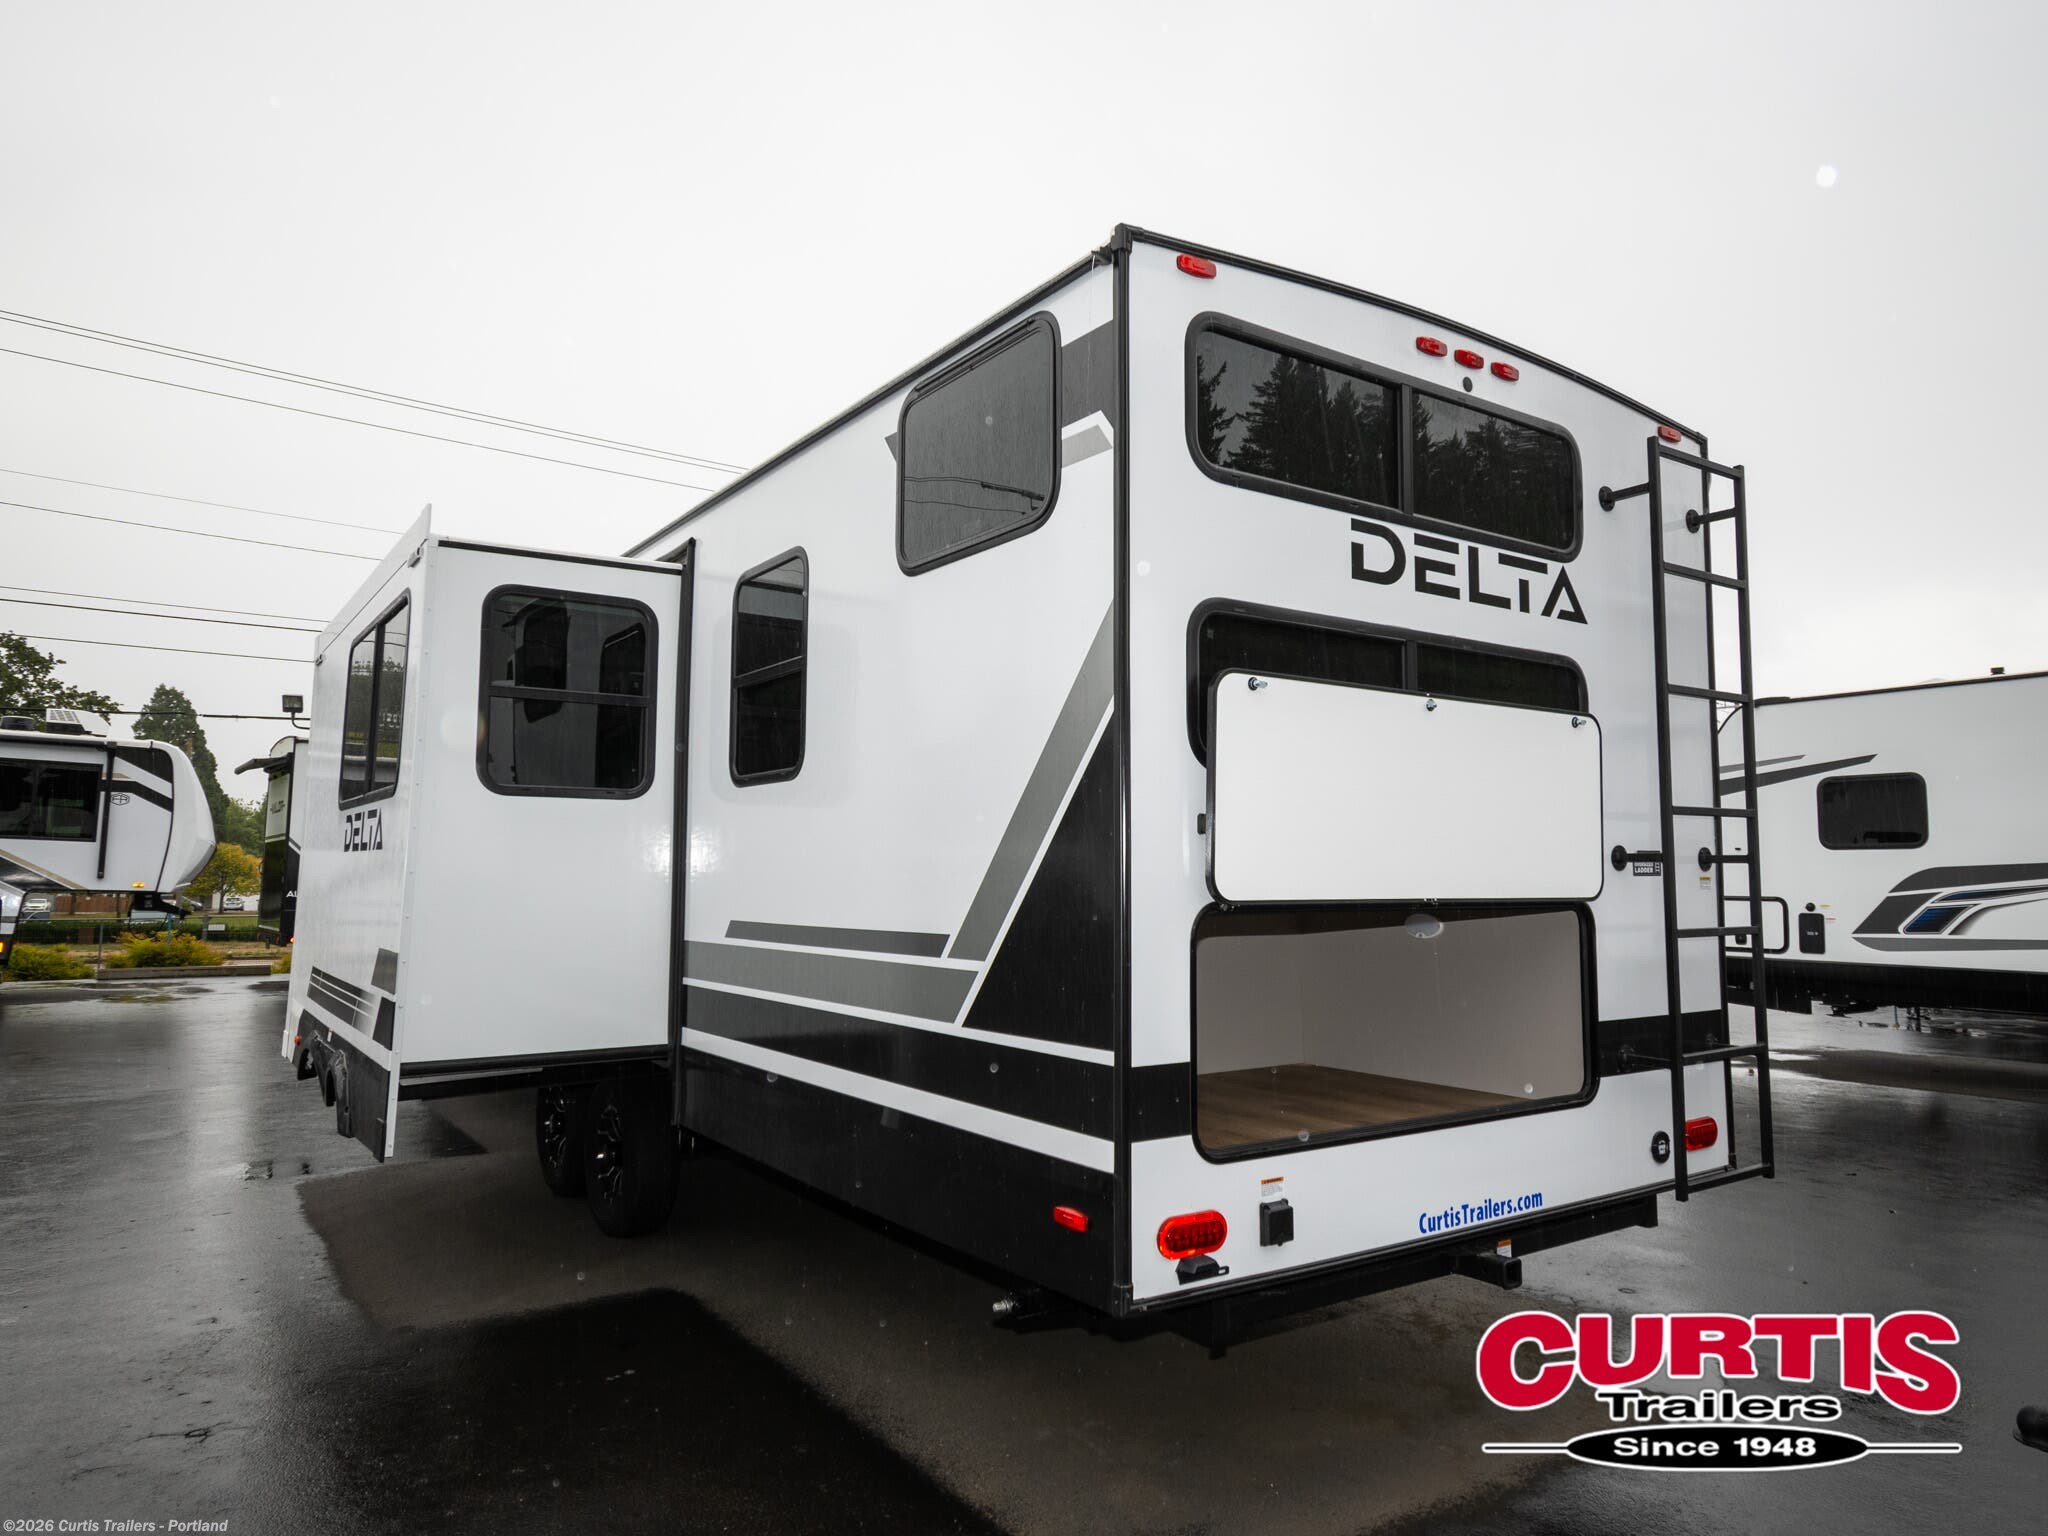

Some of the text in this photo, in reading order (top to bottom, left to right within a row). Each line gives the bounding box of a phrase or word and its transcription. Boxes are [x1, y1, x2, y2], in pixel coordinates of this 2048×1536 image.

[1351, 517, 1588, 624] DELTA
[344, 808, 383, 852] DELTA
[1419, 1192, 1543, 1234] CurtisTrailers.com
